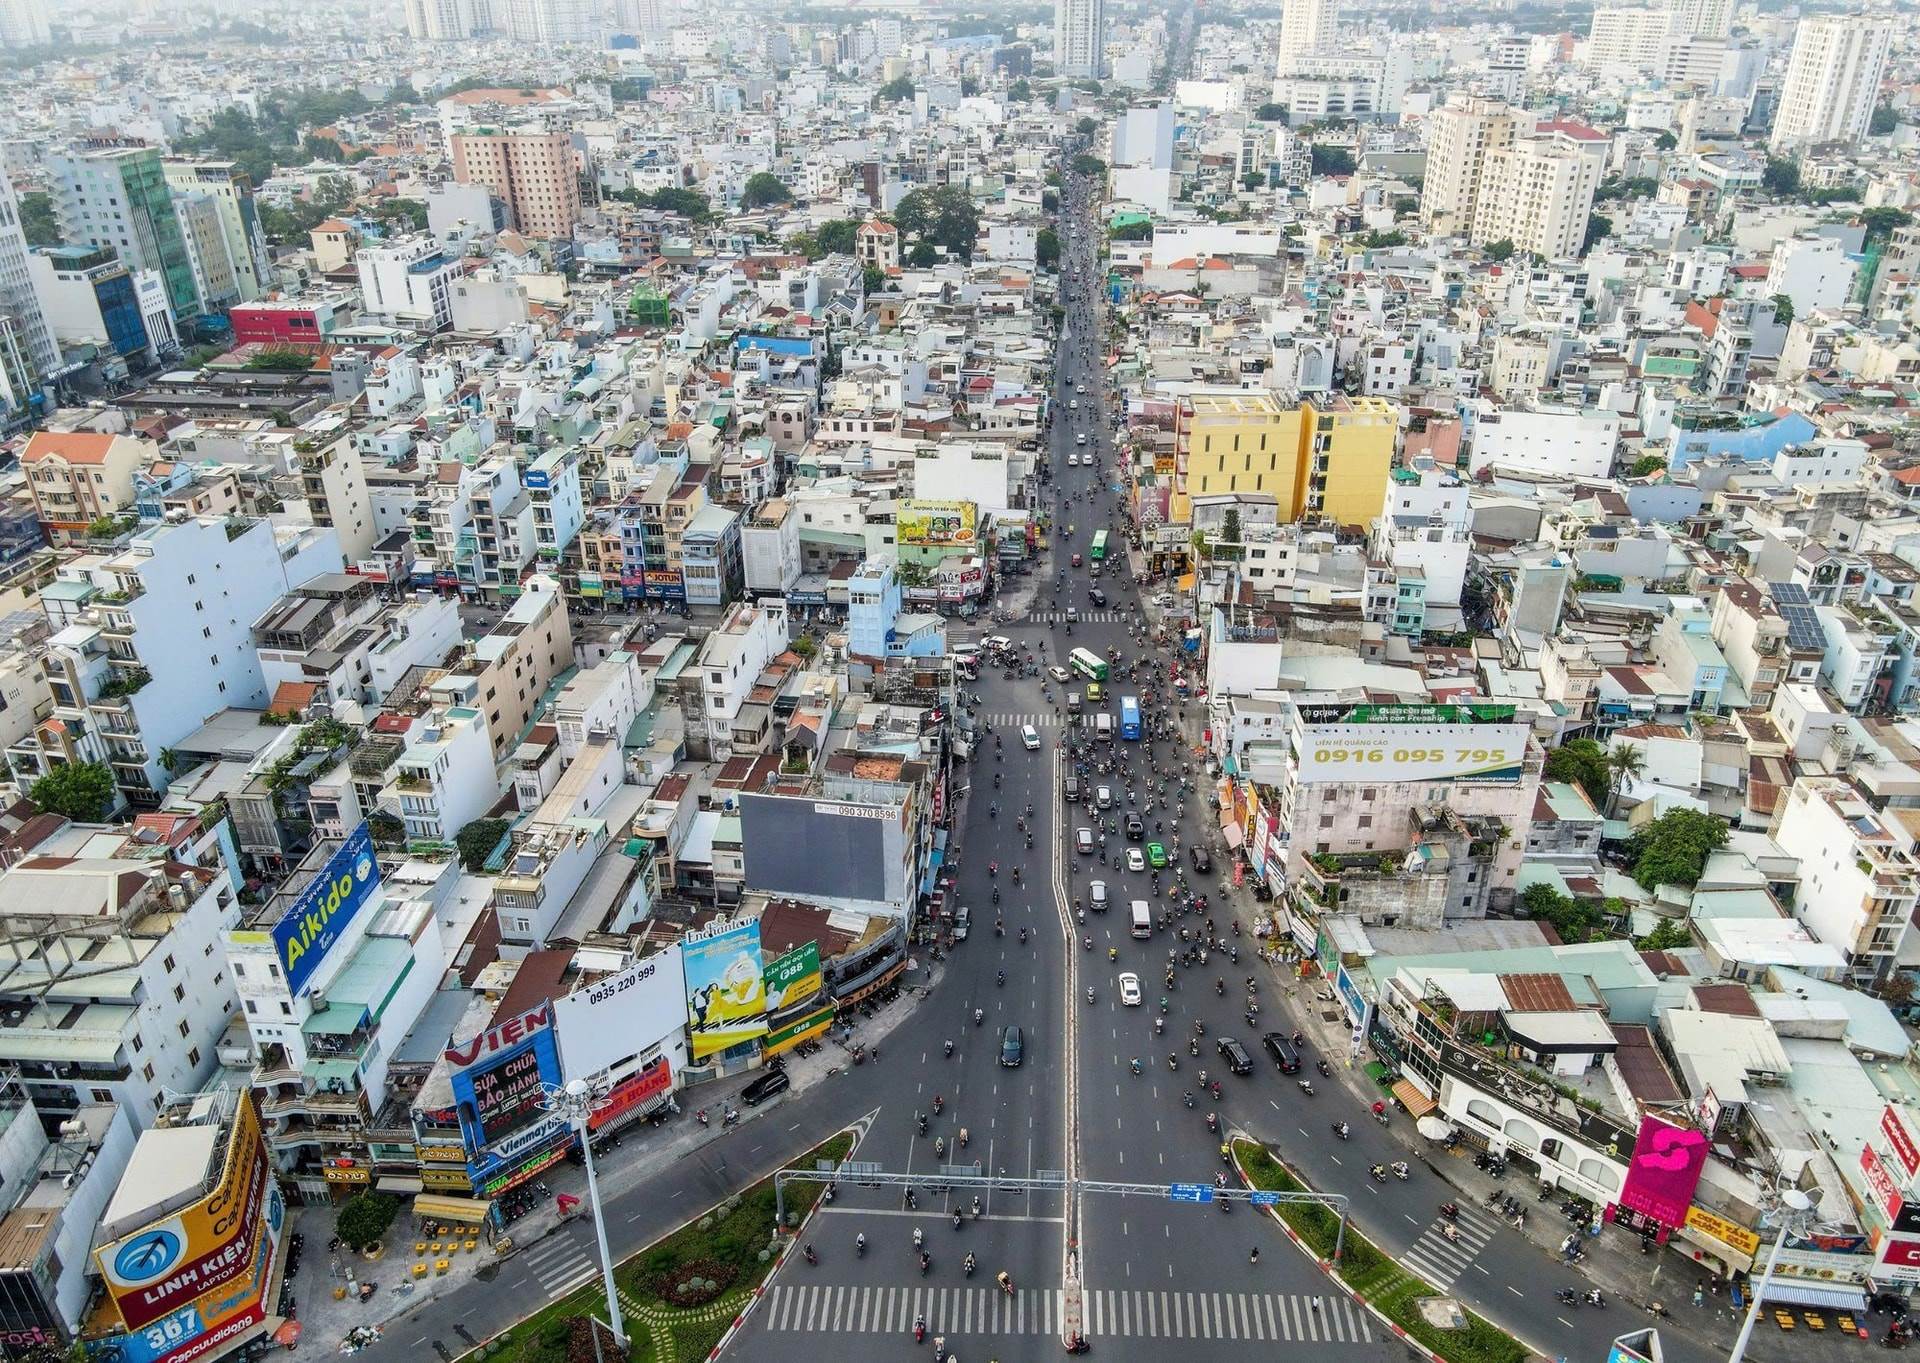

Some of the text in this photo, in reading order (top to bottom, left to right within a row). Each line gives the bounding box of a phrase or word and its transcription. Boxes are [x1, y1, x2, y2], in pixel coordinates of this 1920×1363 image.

[654, 574, 680, 582] JOTUN
[1313, 709, 1339, 718] gojek
[1314, 749, 1505, 763] 0916 095 795
[839, 806, 855, 815] 090
[857, 807, 873, 817] 370
[874, 808, 896, 819] 8596
[287, 874, 353, 971] Aikido
[590, 964, 656, 1005] 0935 220 999
[780, 962, 804, 980] F88
[444, 1007, 548, 1067] VIỆN
[474, 1052, 537, 1094] SỬA CHỮA
[478, 1070, 541, 1112] BẢO HÀNH
[1507, 1140, 1534, 1159] Legend
[143, 1238, 248, 1305] LINH KIỆN
[197, 1265, 236, 1292] LAPTOP
[147, 1308, 199, 1350] 367
